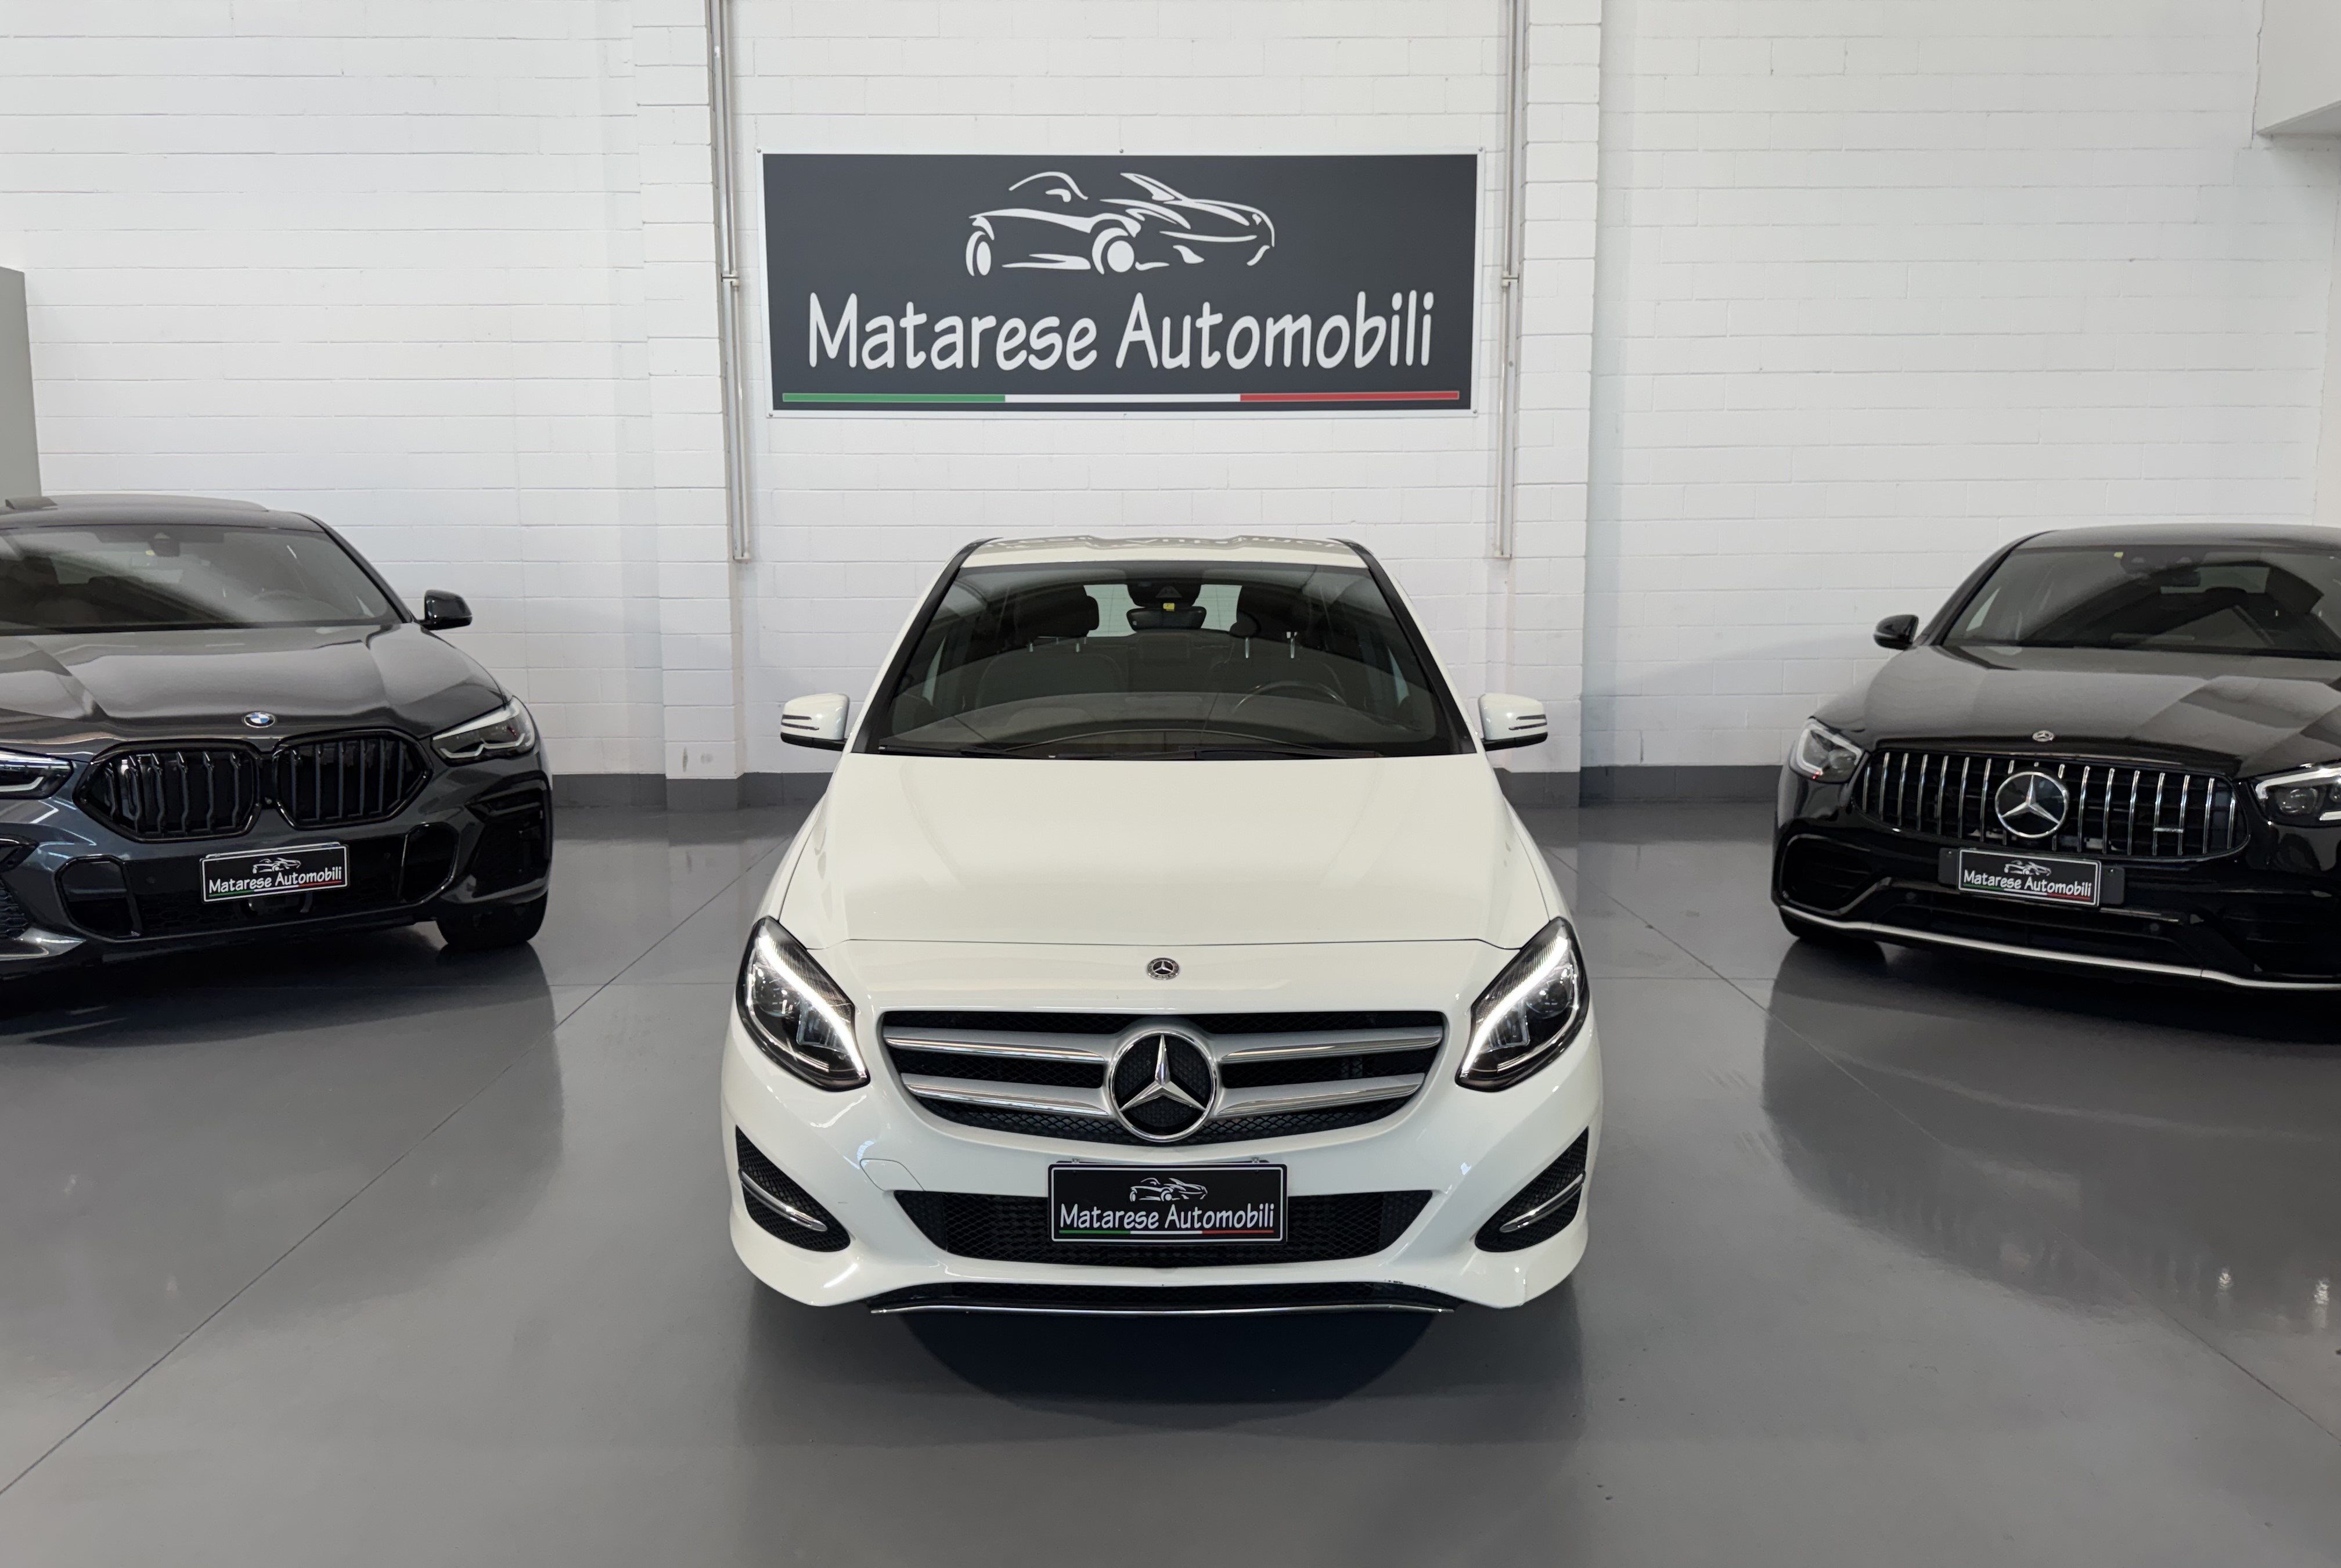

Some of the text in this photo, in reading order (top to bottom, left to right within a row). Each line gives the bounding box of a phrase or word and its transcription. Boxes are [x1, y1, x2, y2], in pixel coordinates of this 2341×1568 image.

[808, 290, 1435, 372] Matarese Automobili
[208, 866, 342, 894] Matarese Automobili
[1963, 869, 2092, 897] Matarese Automobili
[1060, 1203, 1275, 1230] Matarese Automobili
